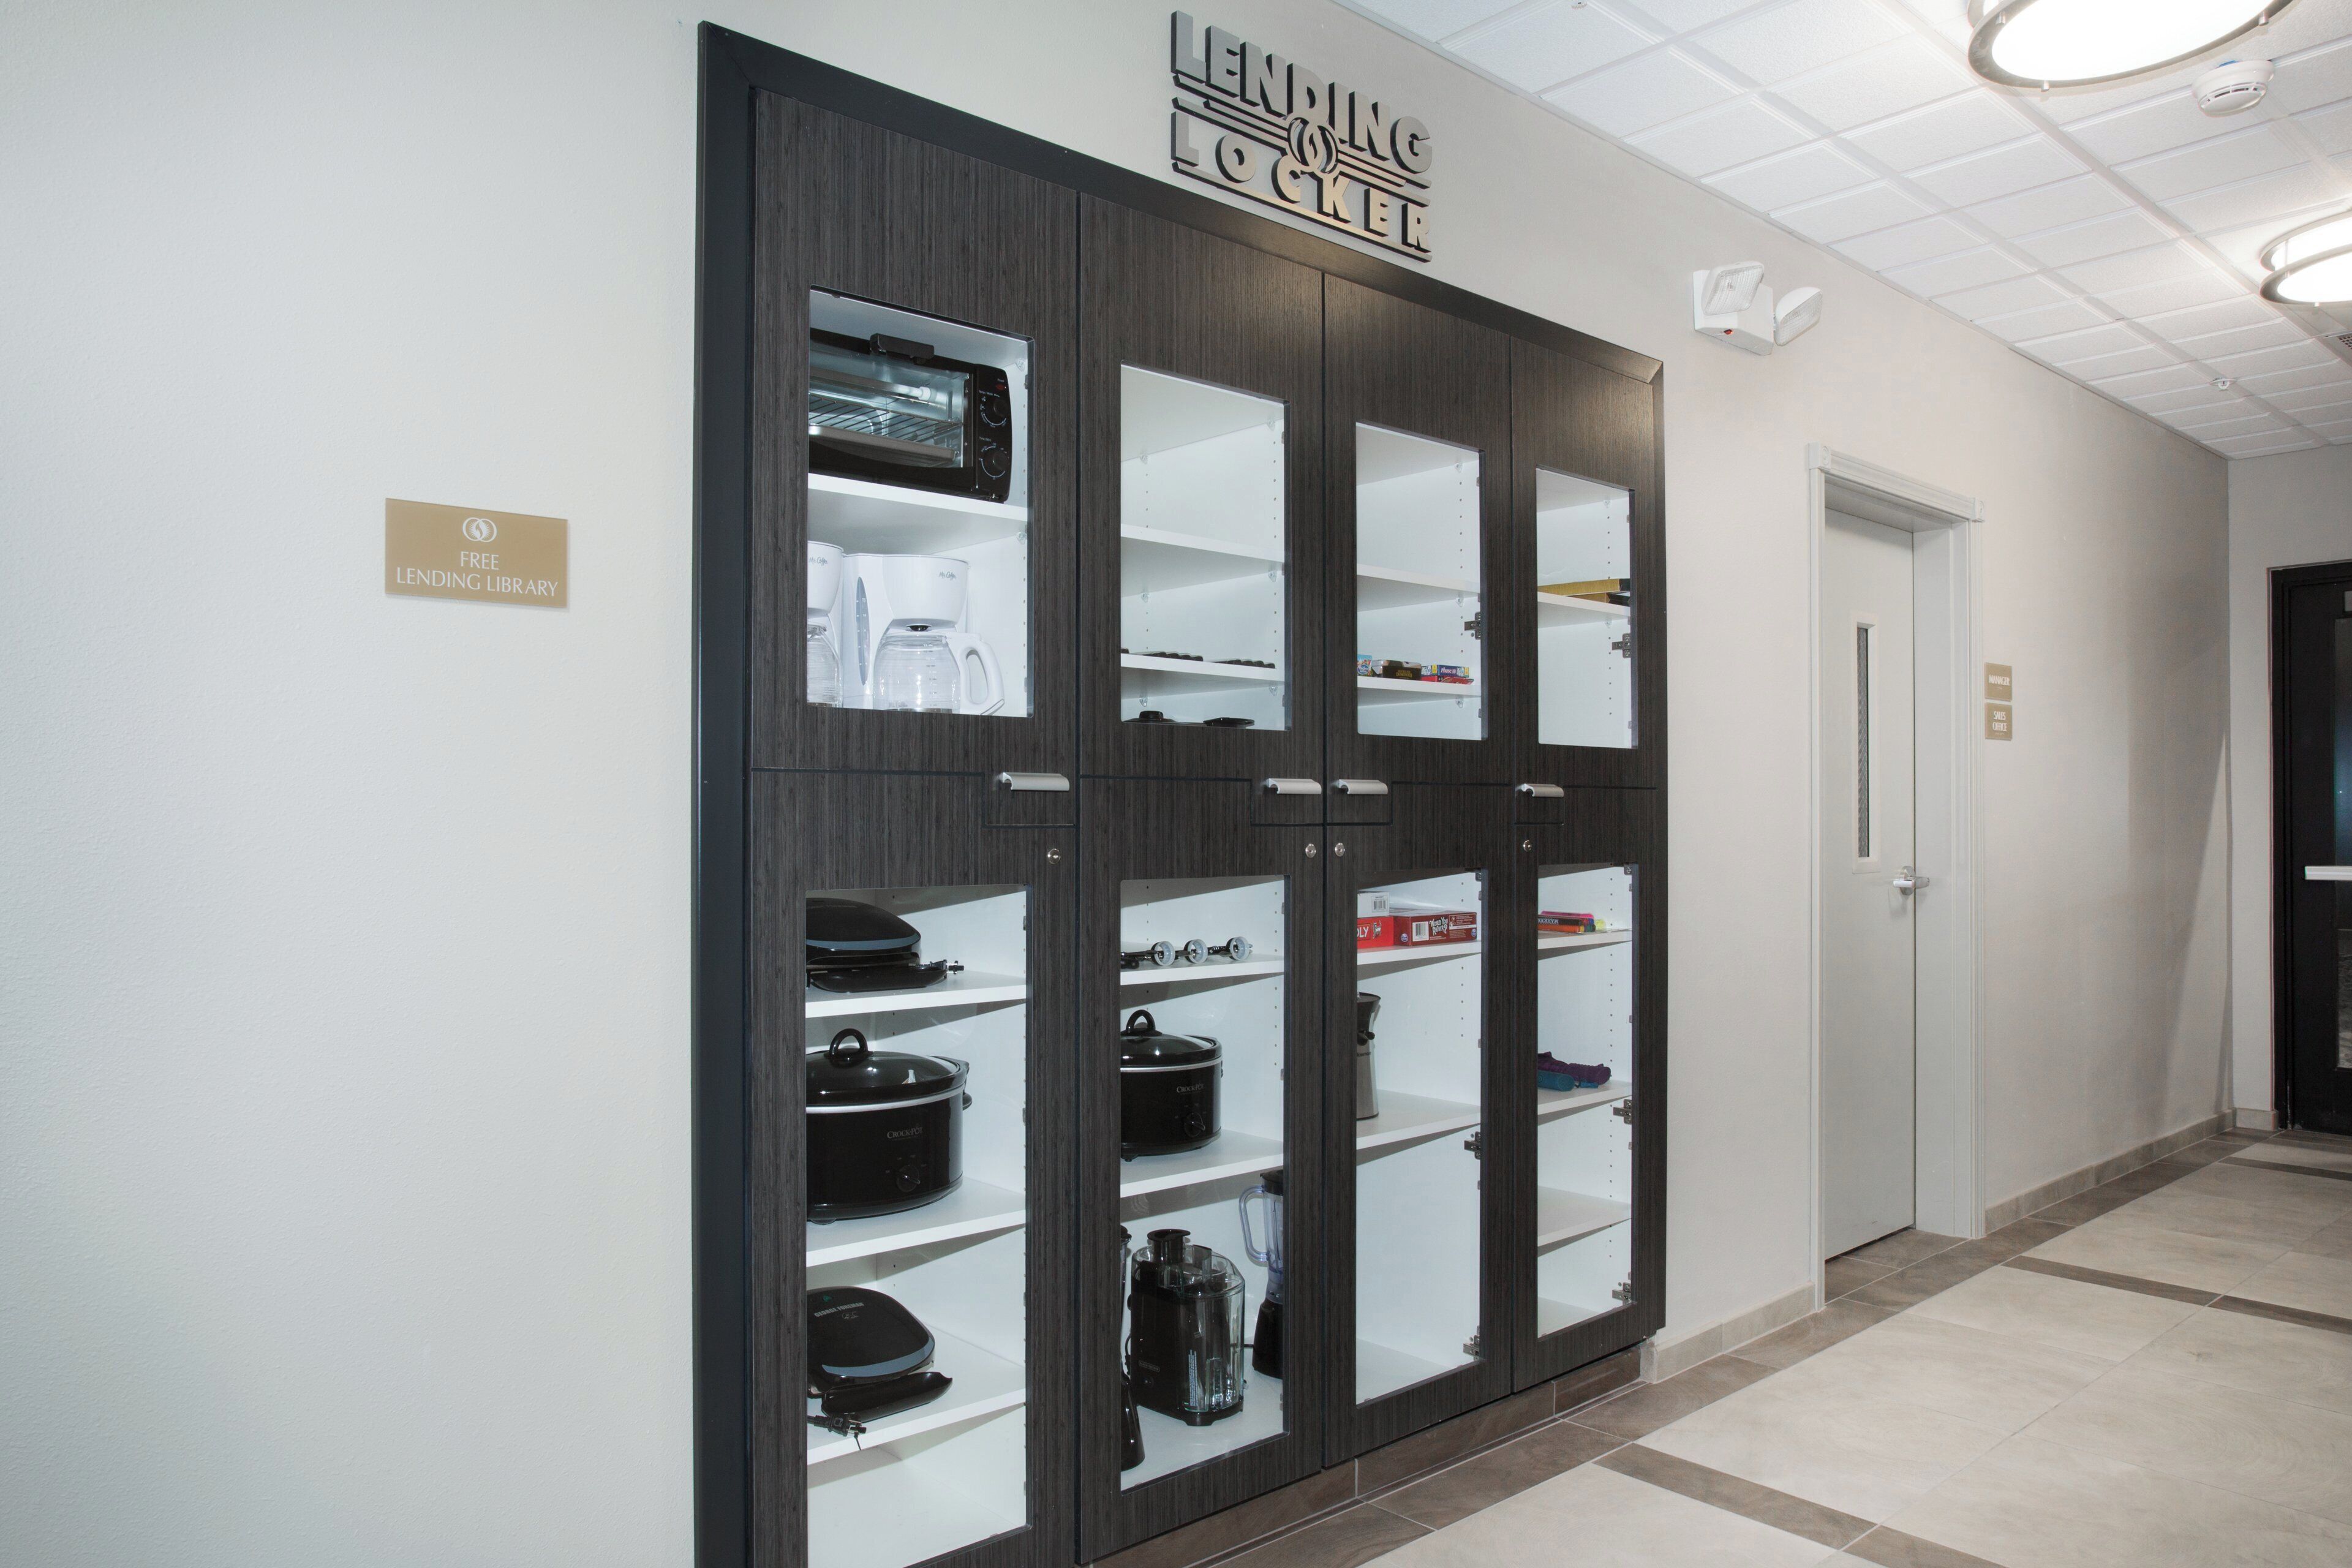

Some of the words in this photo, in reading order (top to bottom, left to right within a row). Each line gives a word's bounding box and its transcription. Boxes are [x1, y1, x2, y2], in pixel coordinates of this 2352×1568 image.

[1171, 10, 1432, 174] LENDING
[1171, 111, 1431, 253] LOCKER
[461, 551, 499, 570] FREE
[397, 567, 480, 590] LENDING
[487, 575, 559, 597] LIBRARY
[1988, 675, 2010, 686] MANAGER
[1993, 710, 2006, 721] SALES
[1992, 722, 2008, 731] OFFICE
